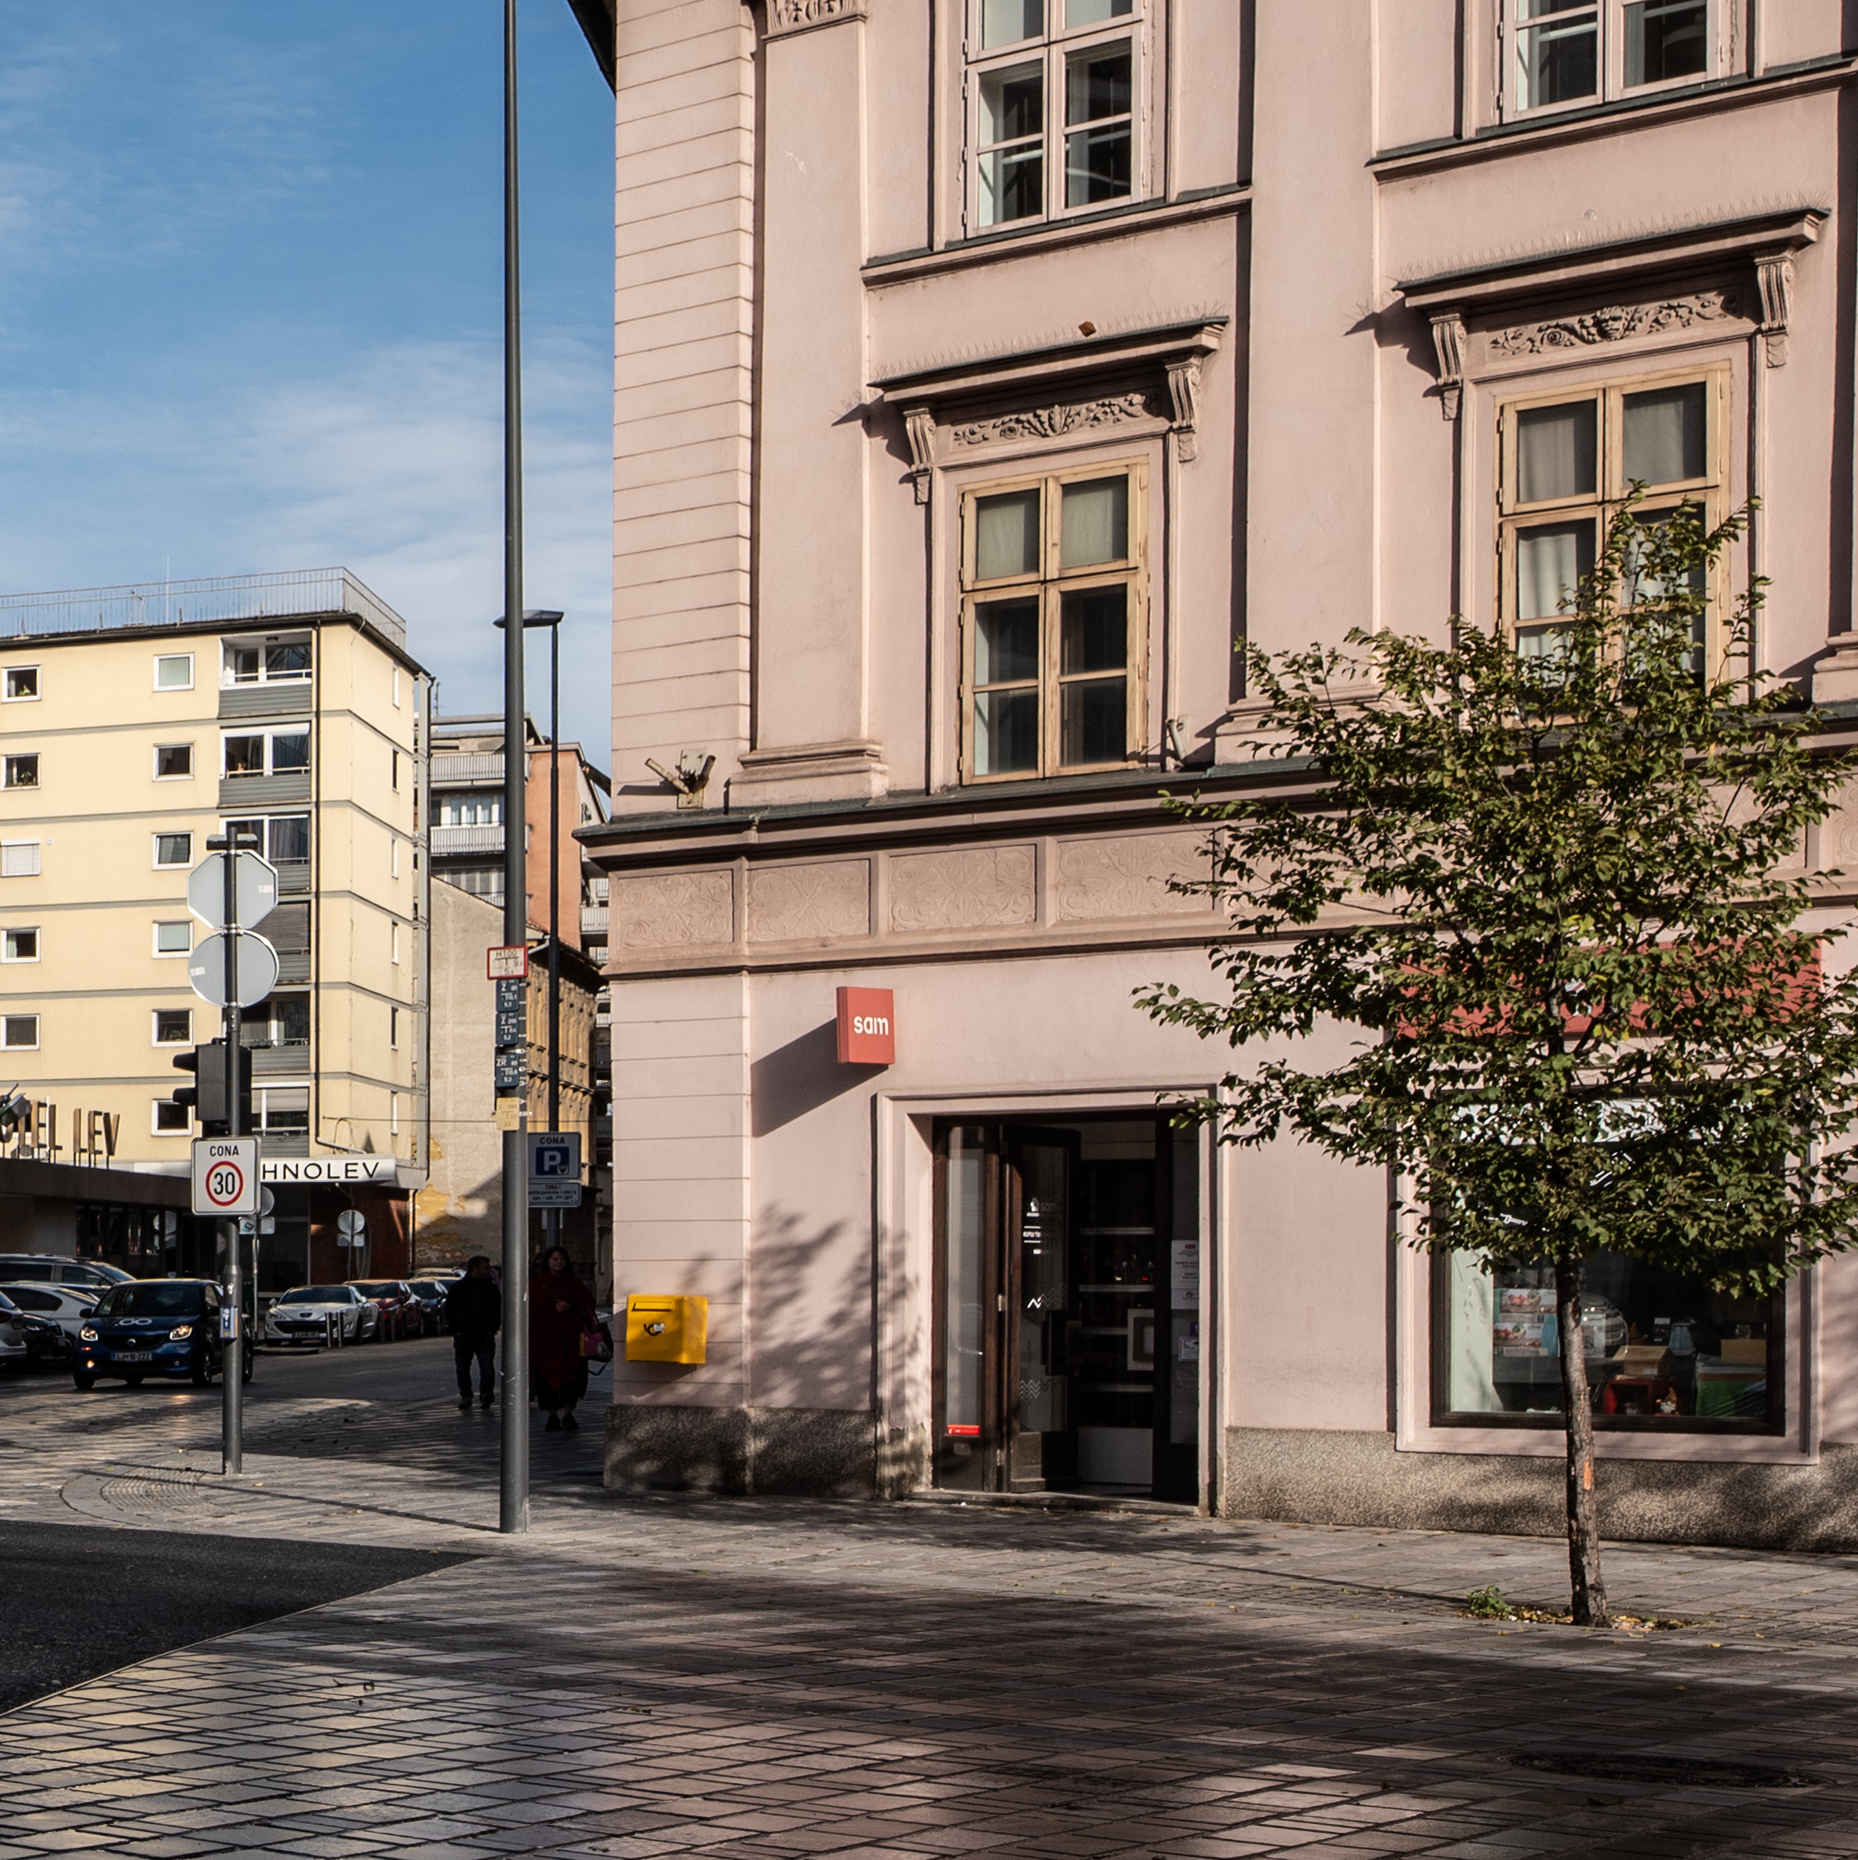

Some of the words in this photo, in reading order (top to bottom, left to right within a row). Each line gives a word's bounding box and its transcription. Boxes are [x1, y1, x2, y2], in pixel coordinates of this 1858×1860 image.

[853, 1015, 889, 1035] sam
[73, 1107, 121, 1156] LEV
[539, 1136, 565, 1145] CONA
[209, 1145, 240, 1157] CONA
[261, 1161, 380, 1181] HNOLEV
[213, 1171, 237, 1196] 30
